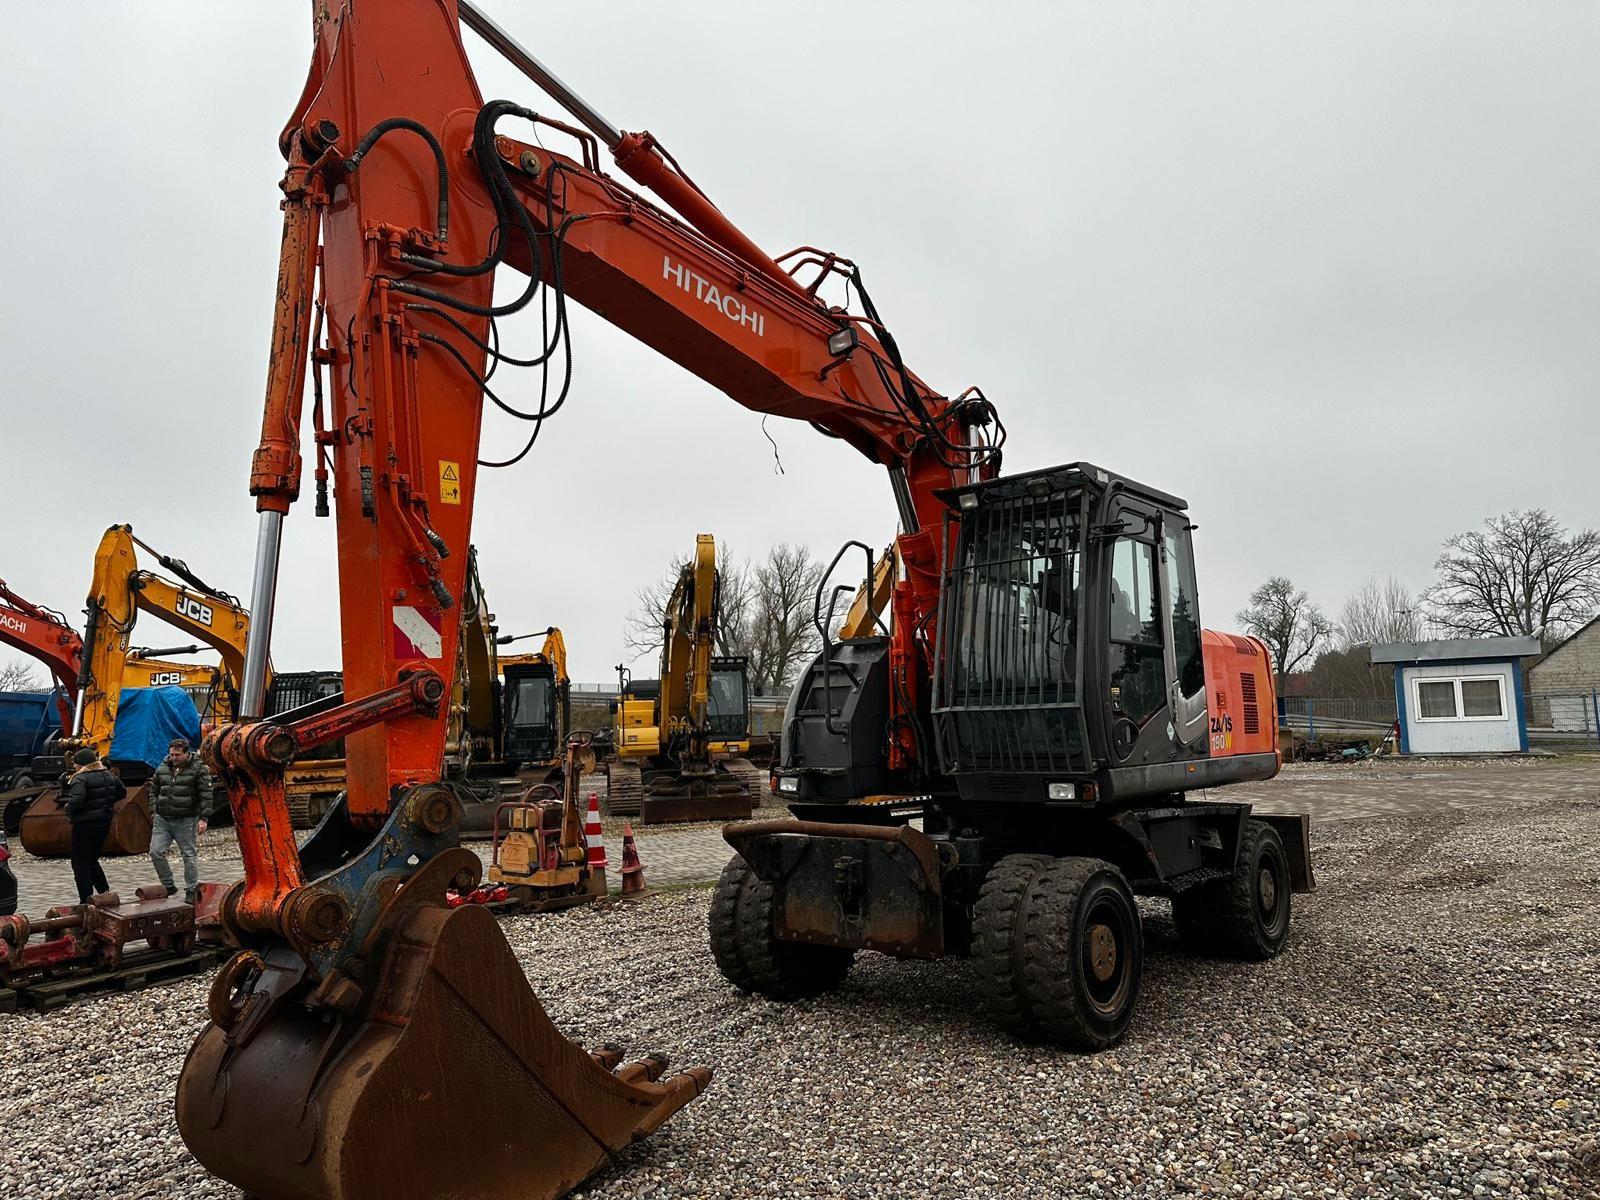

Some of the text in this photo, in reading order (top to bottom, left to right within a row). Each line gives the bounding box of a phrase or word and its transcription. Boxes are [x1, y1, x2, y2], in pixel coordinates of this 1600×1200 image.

[663, 256, 764, 336] HITACHI
[176, 594, 213, 626] JCB
[151, 672, 180, 685] JCB
[1211, 733, 1232, 751] 190W
